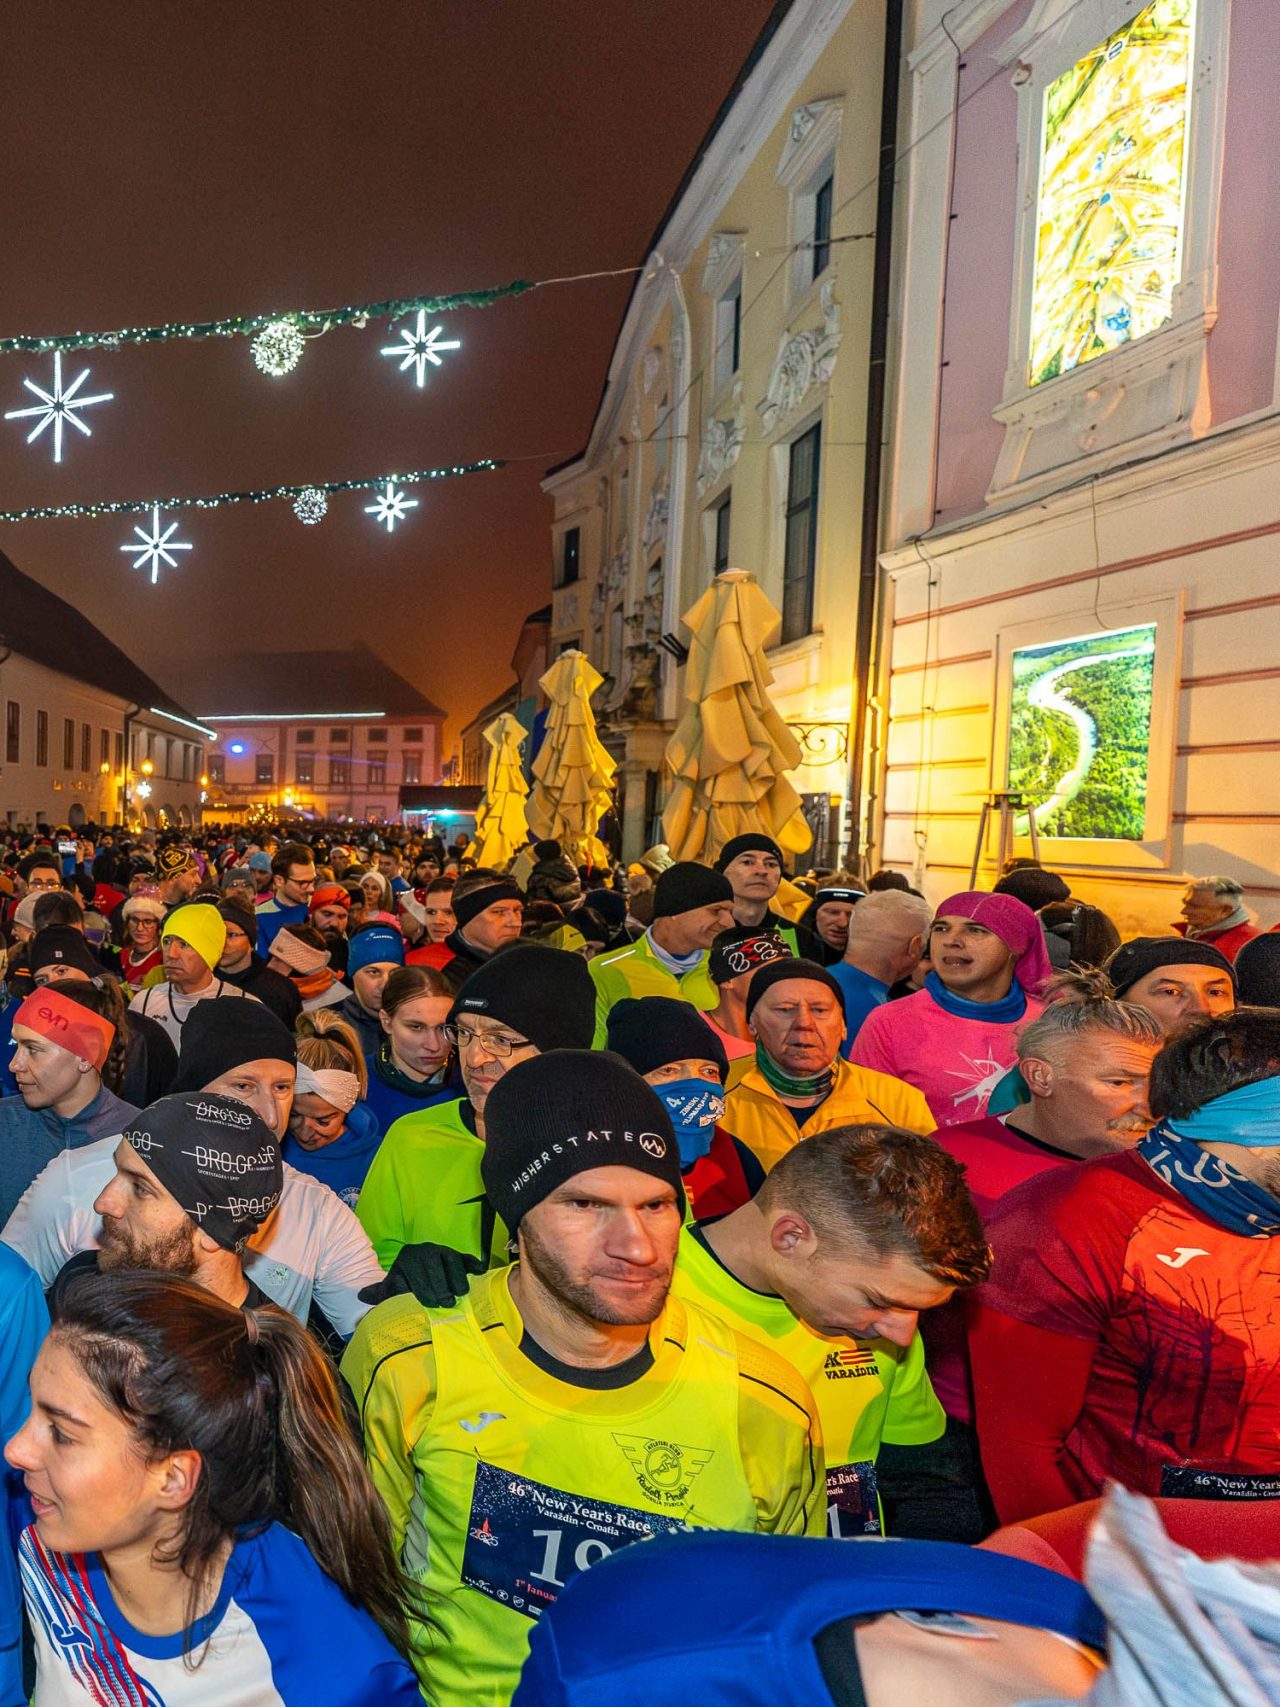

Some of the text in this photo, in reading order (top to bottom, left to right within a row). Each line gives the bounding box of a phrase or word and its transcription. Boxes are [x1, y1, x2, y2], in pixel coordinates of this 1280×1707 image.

[512, 1151, 552, 1193] HIGHER
[825, 1366, 880, 1380] VARAŽDIN
[838, 1473, 859, 1485] Race
[1217, 1478, 1247, 1489] New
[532, 1490, 567, 1512] New
[572, 1501, 613, 1524] Year's
[616, 1512, 651, 1534] Race
[537, 1505, 579, 1526] Varaždin
[586, 1519, 619, 1537] Croatia
